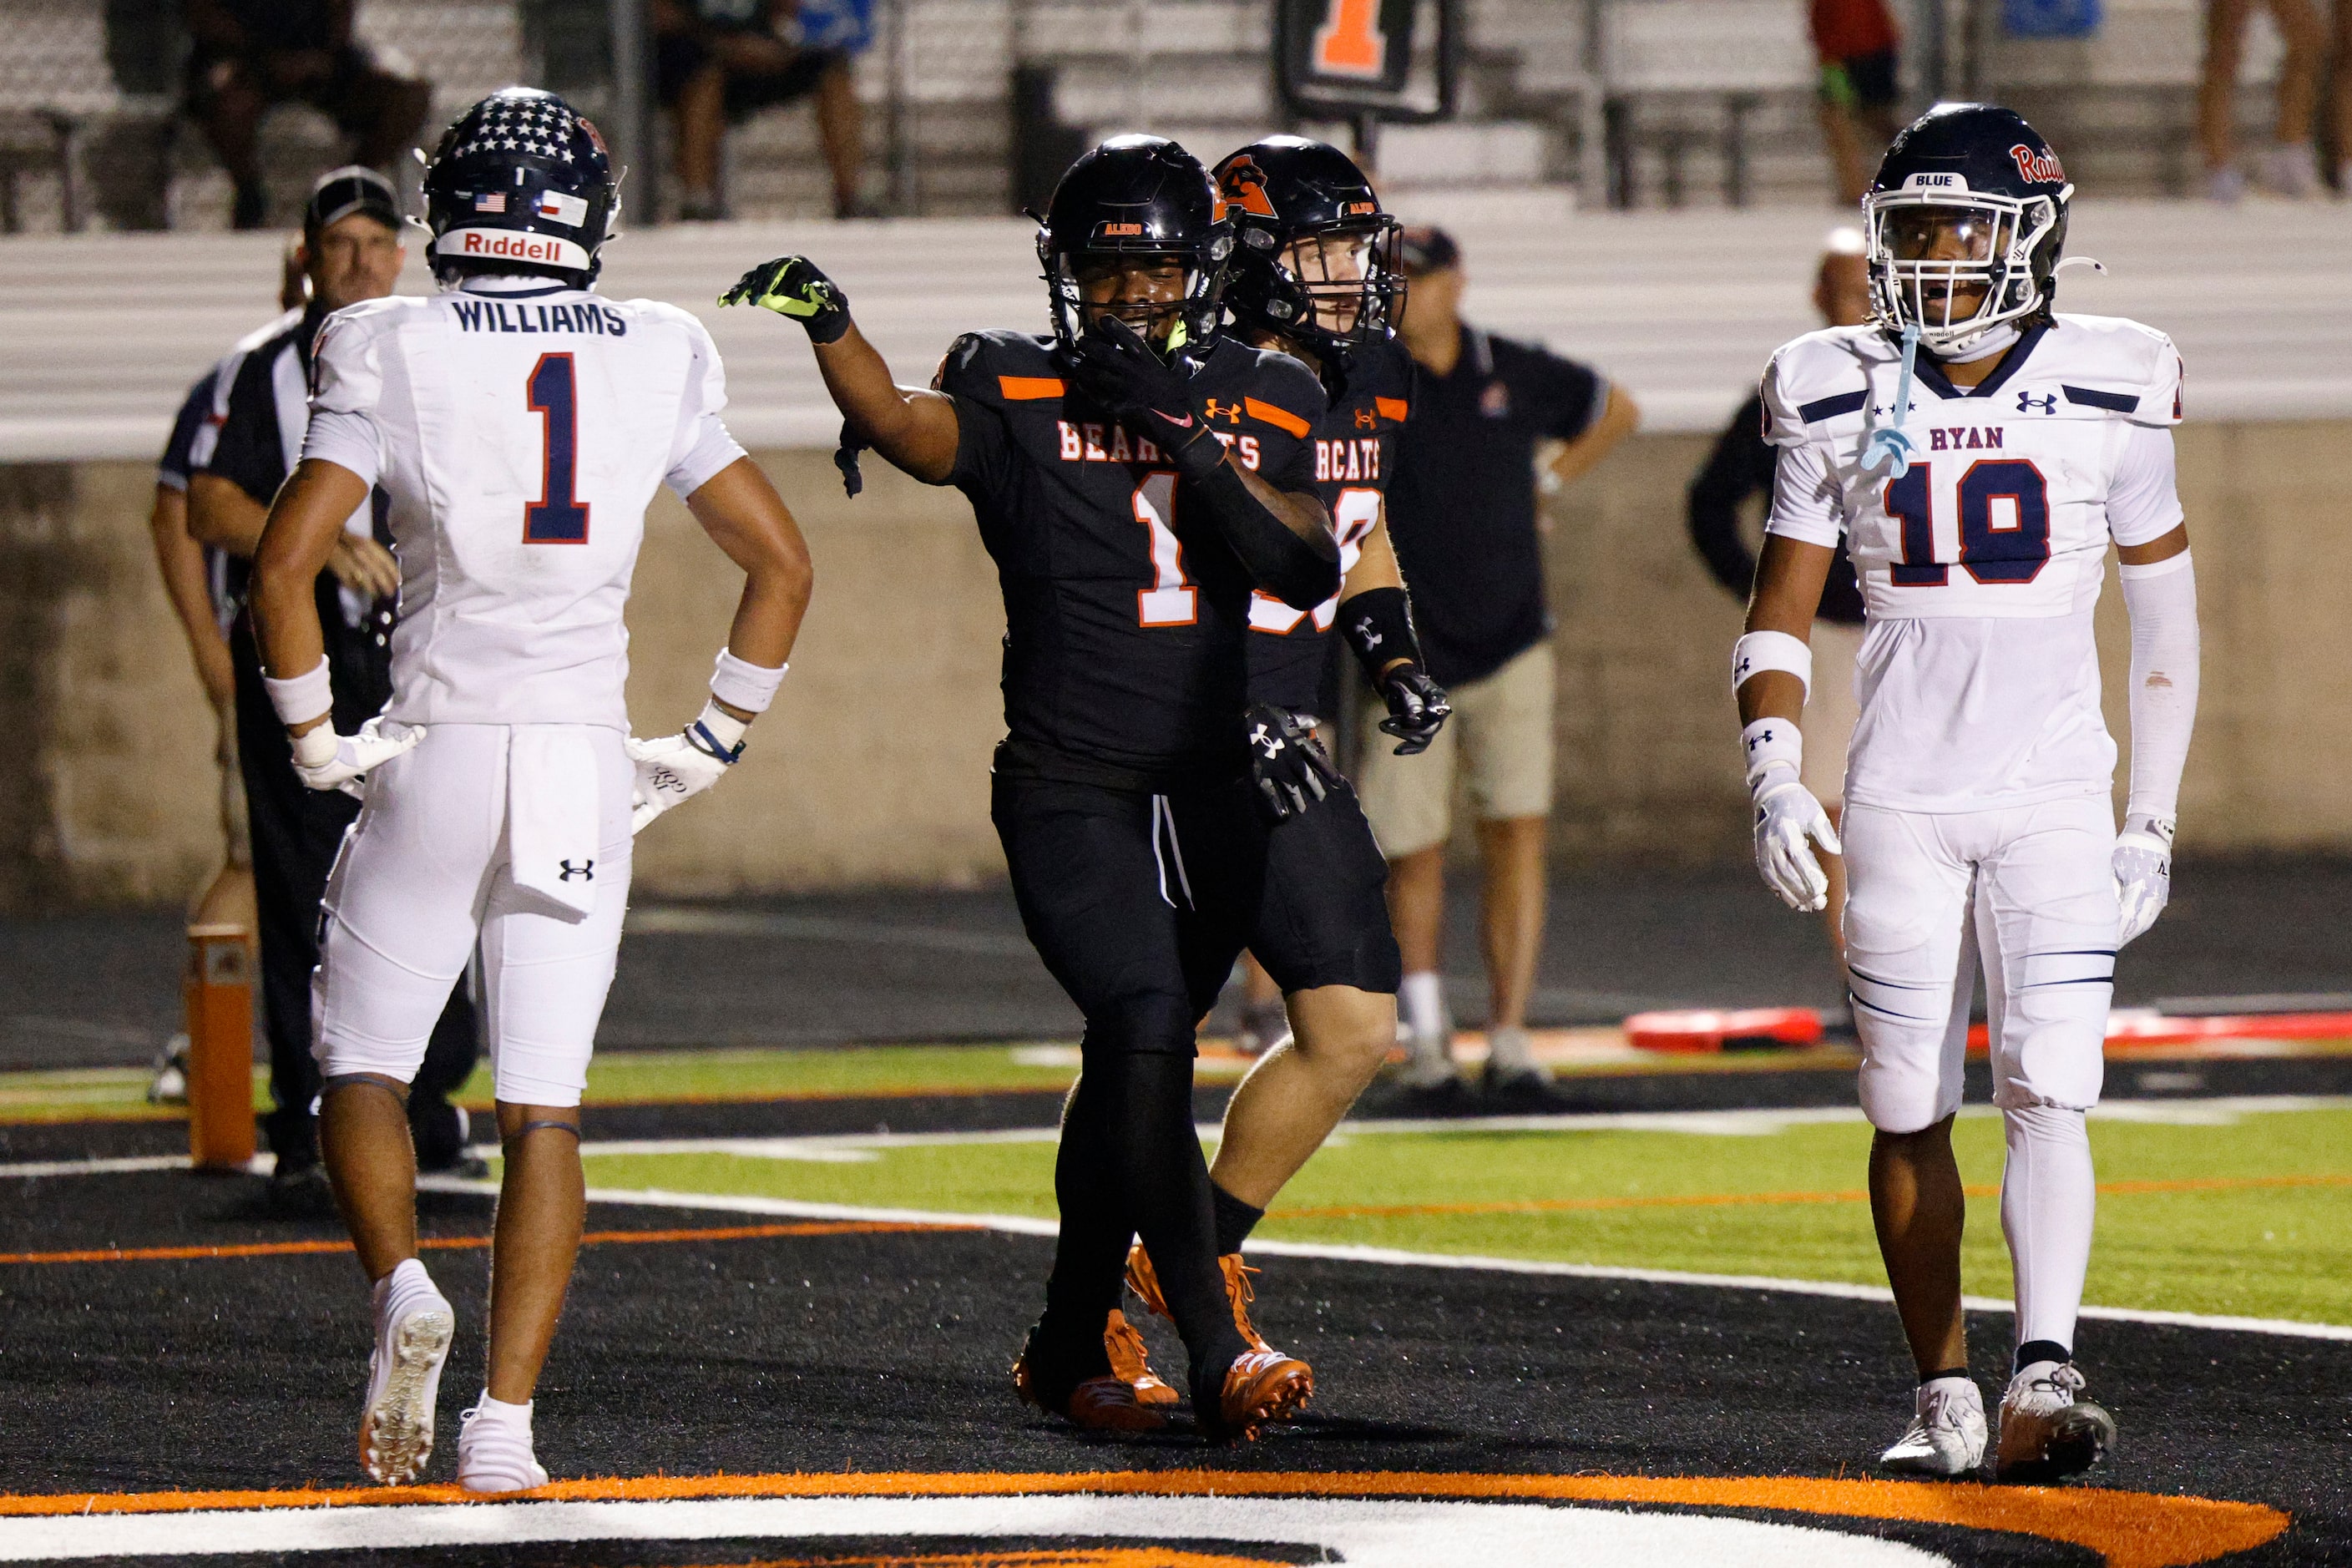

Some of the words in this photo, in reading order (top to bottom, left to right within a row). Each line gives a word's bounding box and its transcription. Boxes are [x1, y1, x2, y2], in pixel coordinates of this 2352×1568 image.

[1915, 175, 1953, 187] BLUE
[2009, 144, 2065, 184] Raid
[1105, 223, 1142, 235] ALEDO
[464, 233, 562, 261] Riddell
[452, 301, 626, 336] WILLIAMS
[522, 352, 590, 544] 1
[1930, 427, 2004, 450] RYAN
[1315, 438, 1381, 482] RCATS
[1884, 459, 2051, 587] 18
[1131, 470, 1199, 628] 1
[655, 766, 687, 793] GOD
